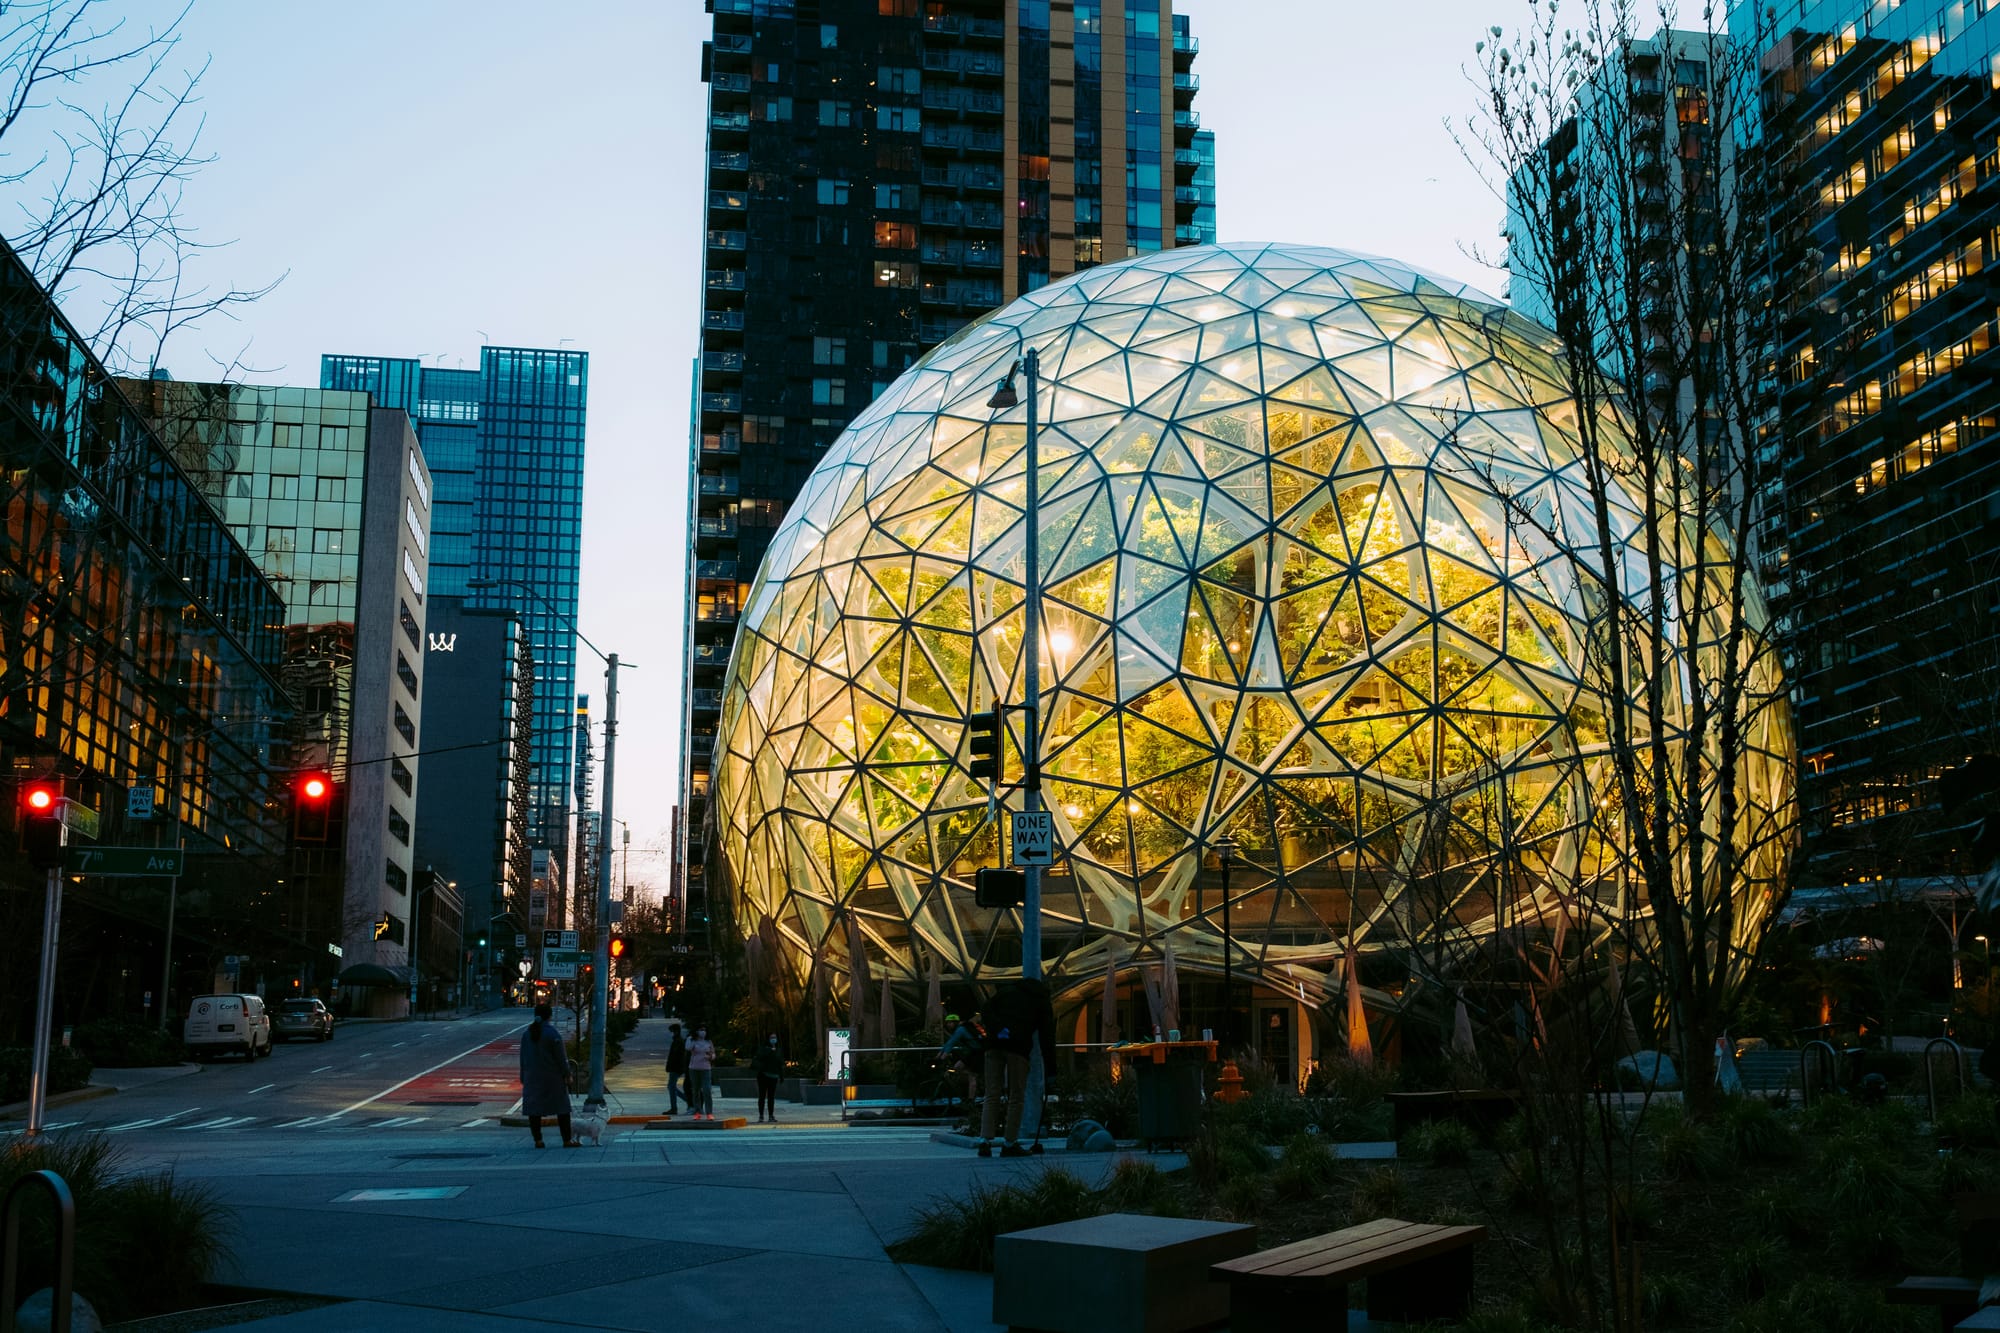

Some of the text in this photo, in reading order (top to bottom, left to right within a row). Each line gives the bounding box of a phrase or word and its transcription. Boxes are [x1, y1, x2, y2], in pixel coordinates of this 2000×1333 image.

[132, 789, 150, 798] ONE
[131, 798, 151, 806] WAY
[1017, 815, 1047, 829] ONE
[1016, 831, 1048, 844] WAY
[75, 850, 175, 871] 7th Ave
